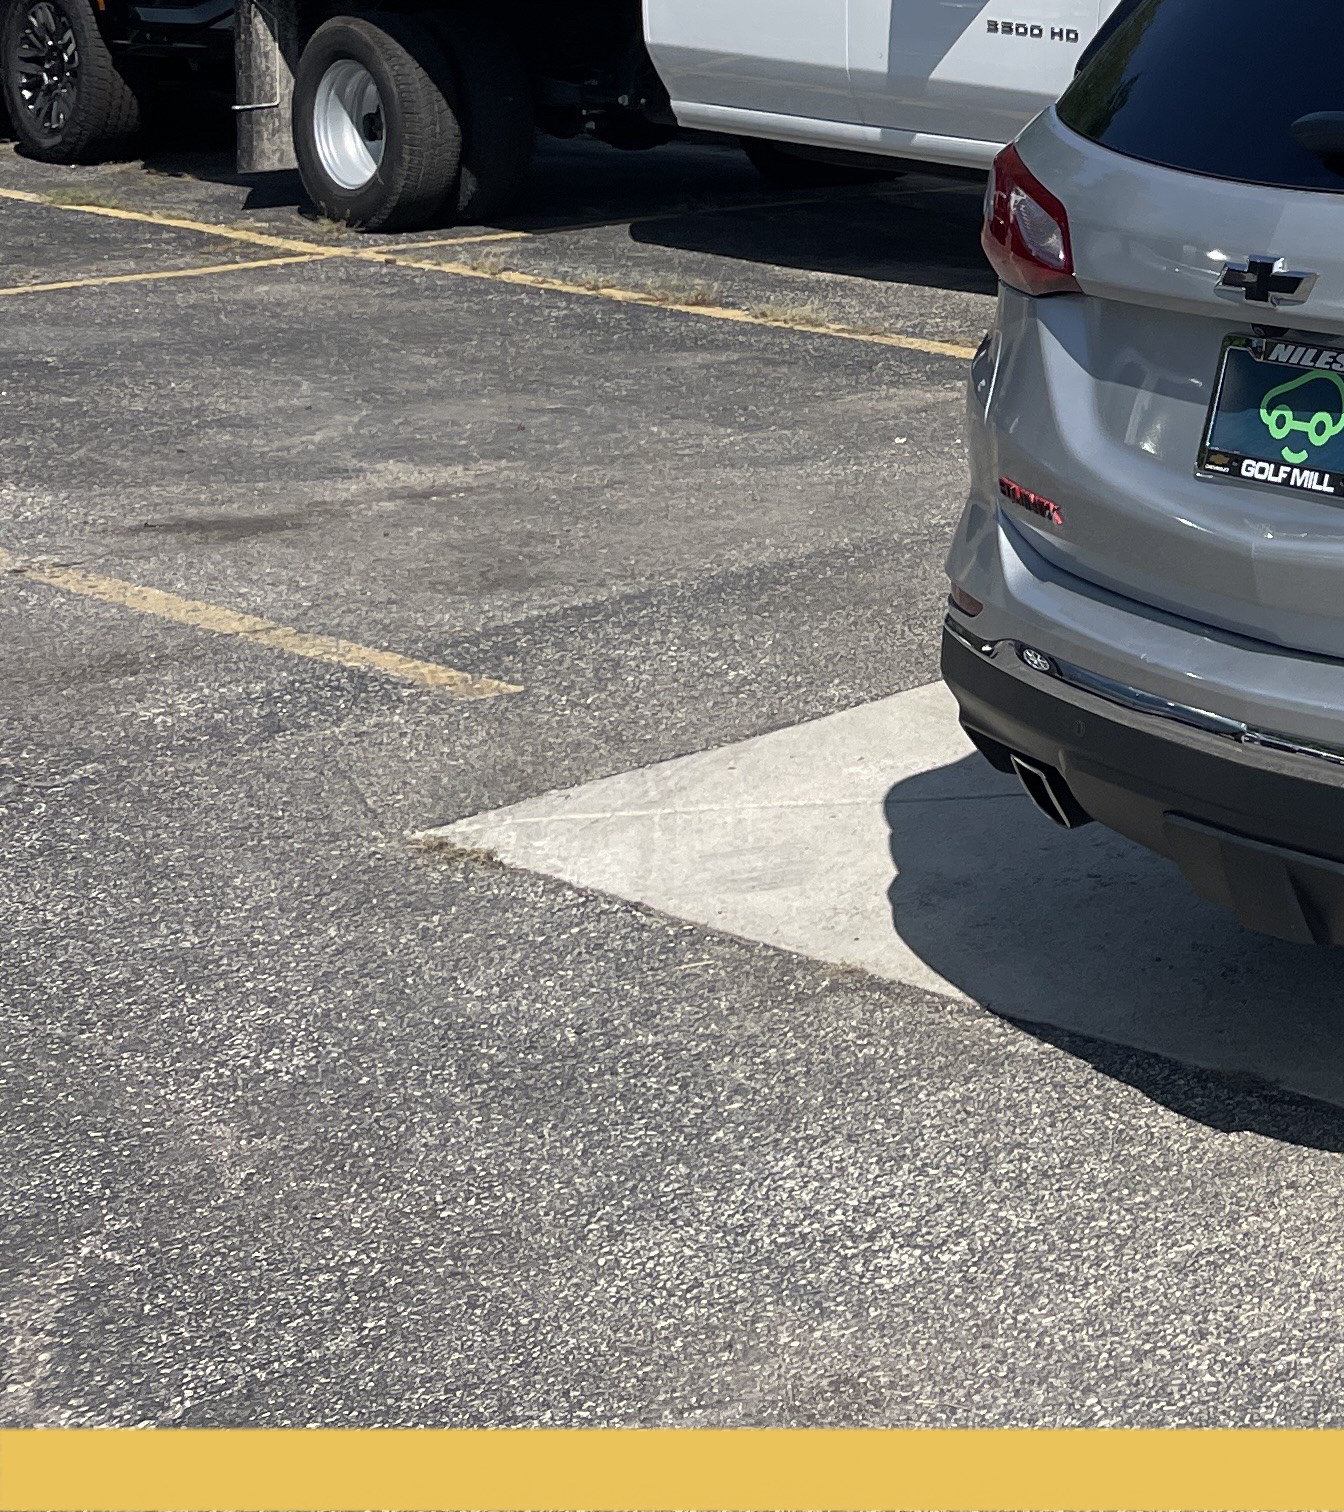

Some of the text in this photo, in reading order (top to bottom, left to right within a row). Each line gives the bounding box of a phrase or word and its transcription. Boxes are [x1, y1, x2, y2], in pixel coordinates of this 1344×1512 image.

[1050, 26, 1079, 43] HD
[1240, 459, 1335, 493] GOLF MILL
